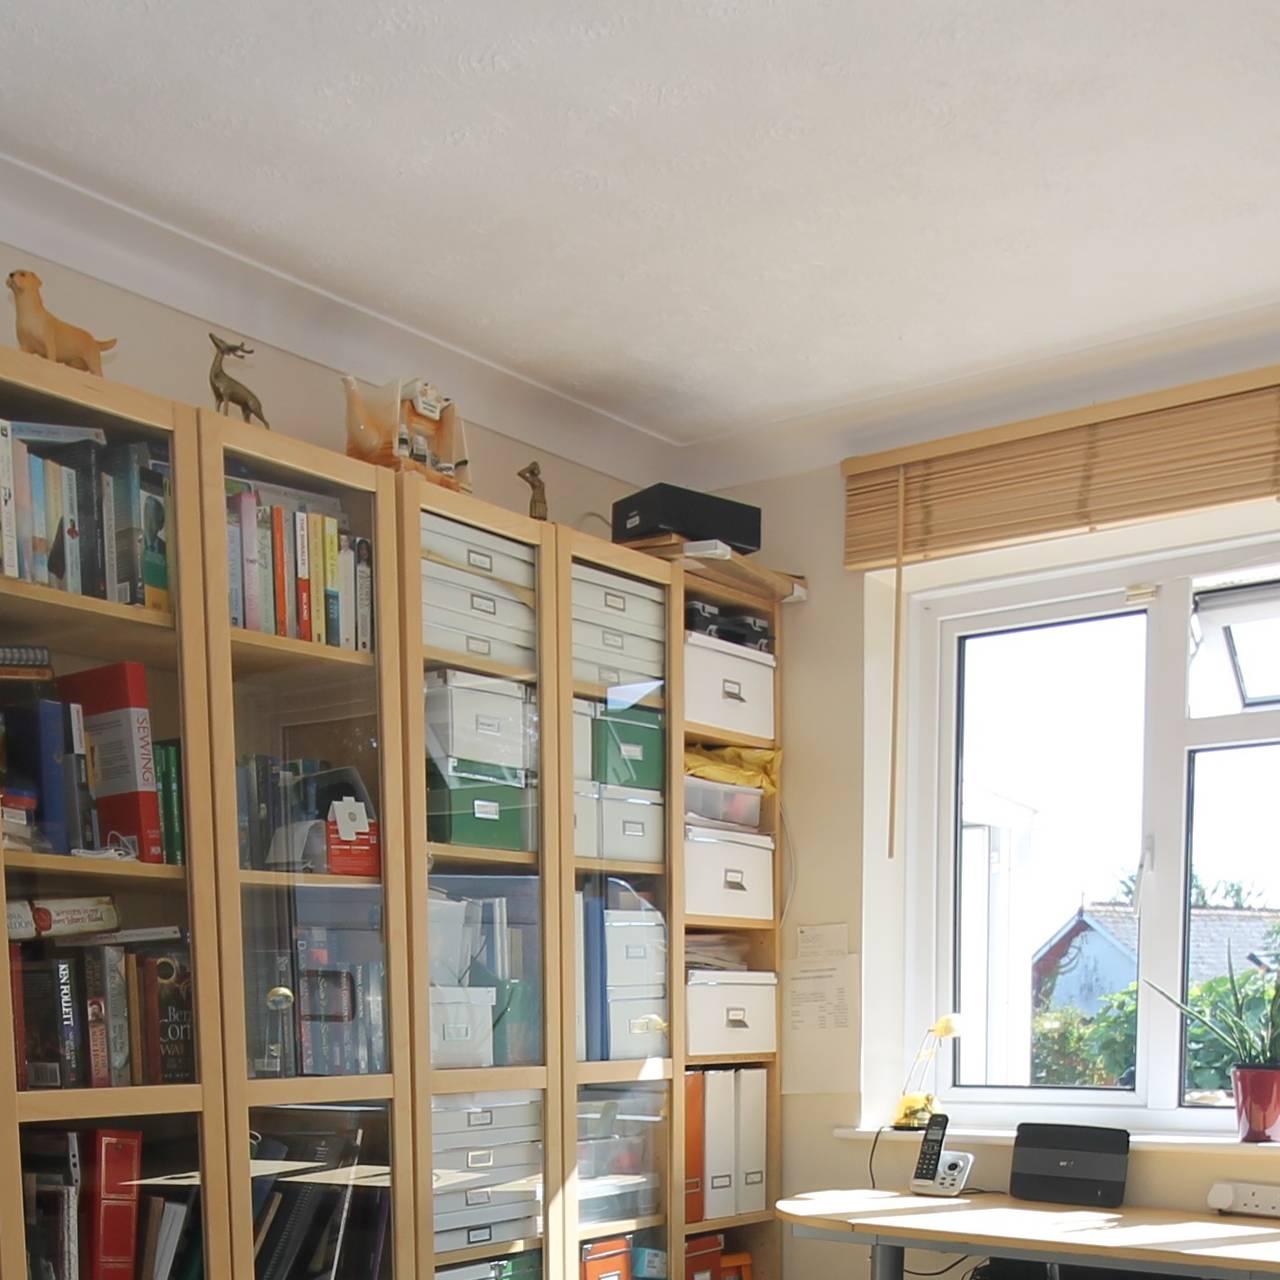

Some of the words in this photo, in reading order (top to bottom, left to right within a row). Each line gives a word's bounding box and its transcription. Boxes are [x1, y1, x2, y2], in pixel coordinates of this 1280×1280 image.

[136, 717, 154, 782] SEWING
[58, 964, 69, 983] KEN
[60, 985, 74, 1027] FOLLETT
